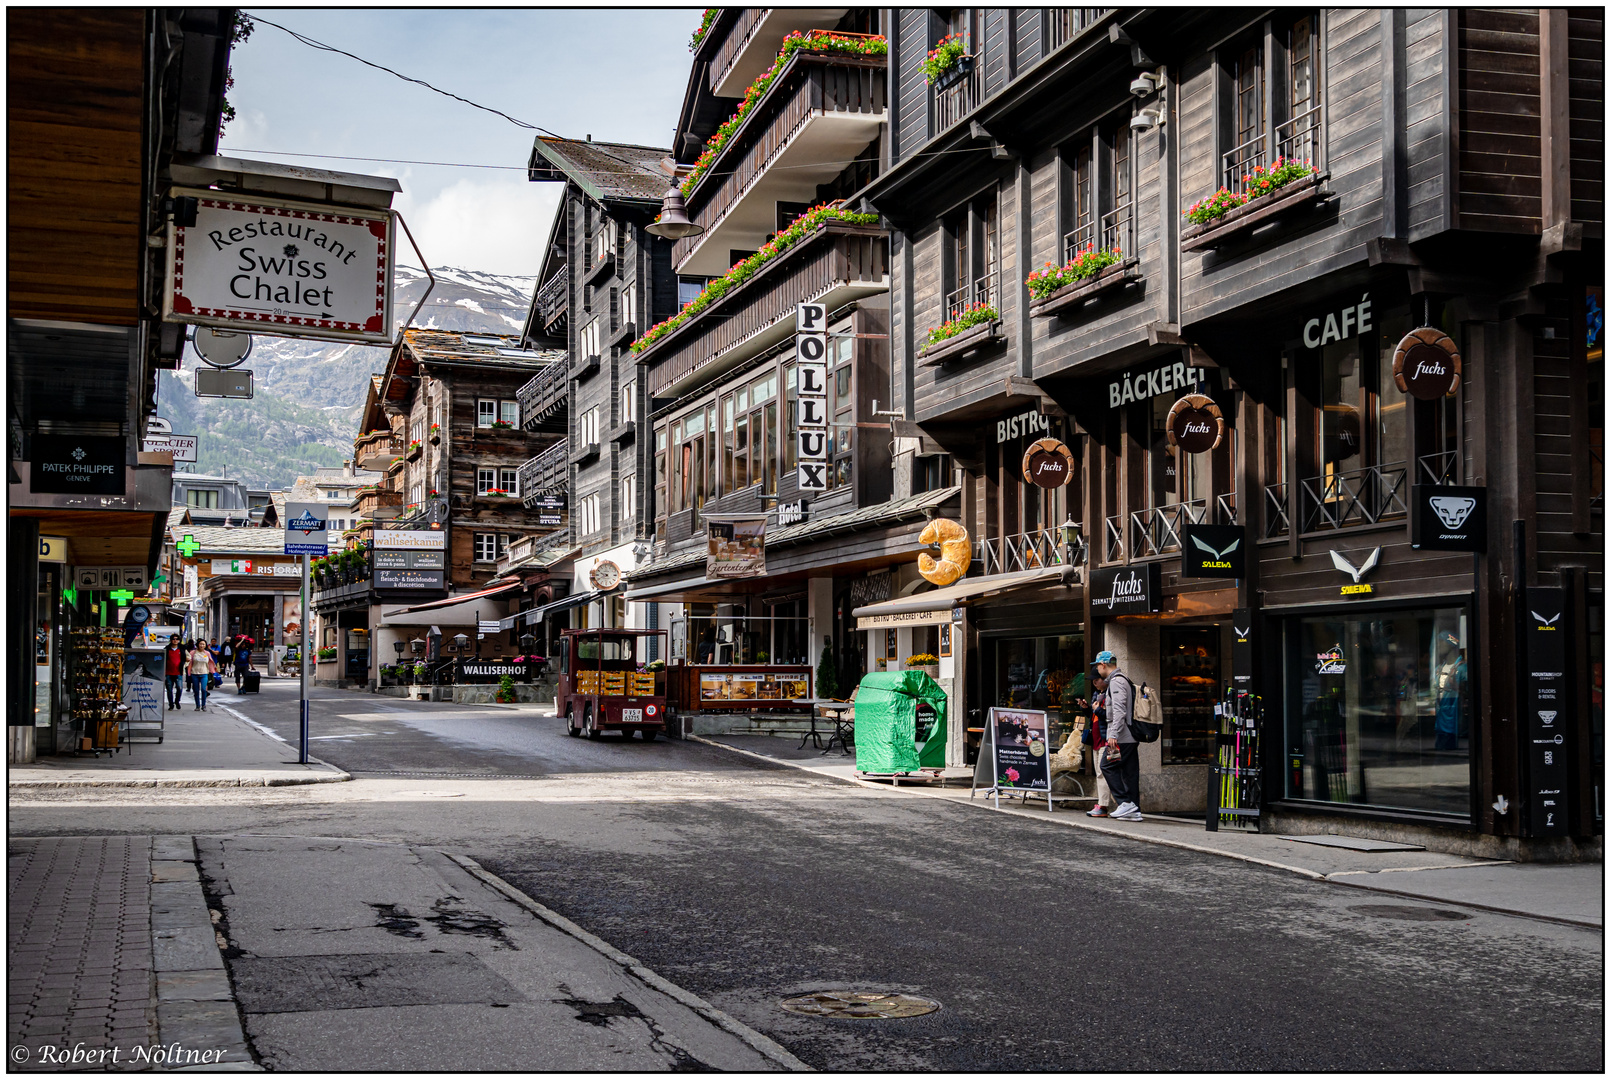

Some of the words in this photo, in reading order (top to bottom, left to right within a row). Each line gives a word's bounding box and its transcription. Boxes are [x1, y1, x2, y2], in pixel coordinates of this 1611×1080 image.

[208, 217, 357, 266] Restaurant
[238, 247, 327, 280] Swiss
[229, 274, 334, 308] Chalet
[1303, 291, 1373, 349] CAFÉ
[1411, 360, 1446, 380] fuchs
[1109, 361, 1205, 409] BÄCKEREI
[801, 305, 825, 488] POLLUX
[996, 410, 1049, 444] BISTRO
[1180, 421, 1211, 438] fuchs
[43, 463, 71, 473] PATEK
[73, 464, 115, 475] PHILIPPE
[1036, 460, 1063, 475] fuchs
[778, 498, 802, 526] Hotel
[375, 537, 444, 547] walliserkanne
[1201, 560, 1232, 568] SALEWA
[1107, 570, 1143, 610] fuchs
[1340, 583, 1373, 595] SALEWA
[1092, 597, 1112, 606] ZERMATT
[1113, 594, 1146, 604] SWITZERLAND
[463, 665, 527, 675] WALLISERHOF
[648, 706, 655, 714] 20
[1030, 778, 1047, 788] fuchs
